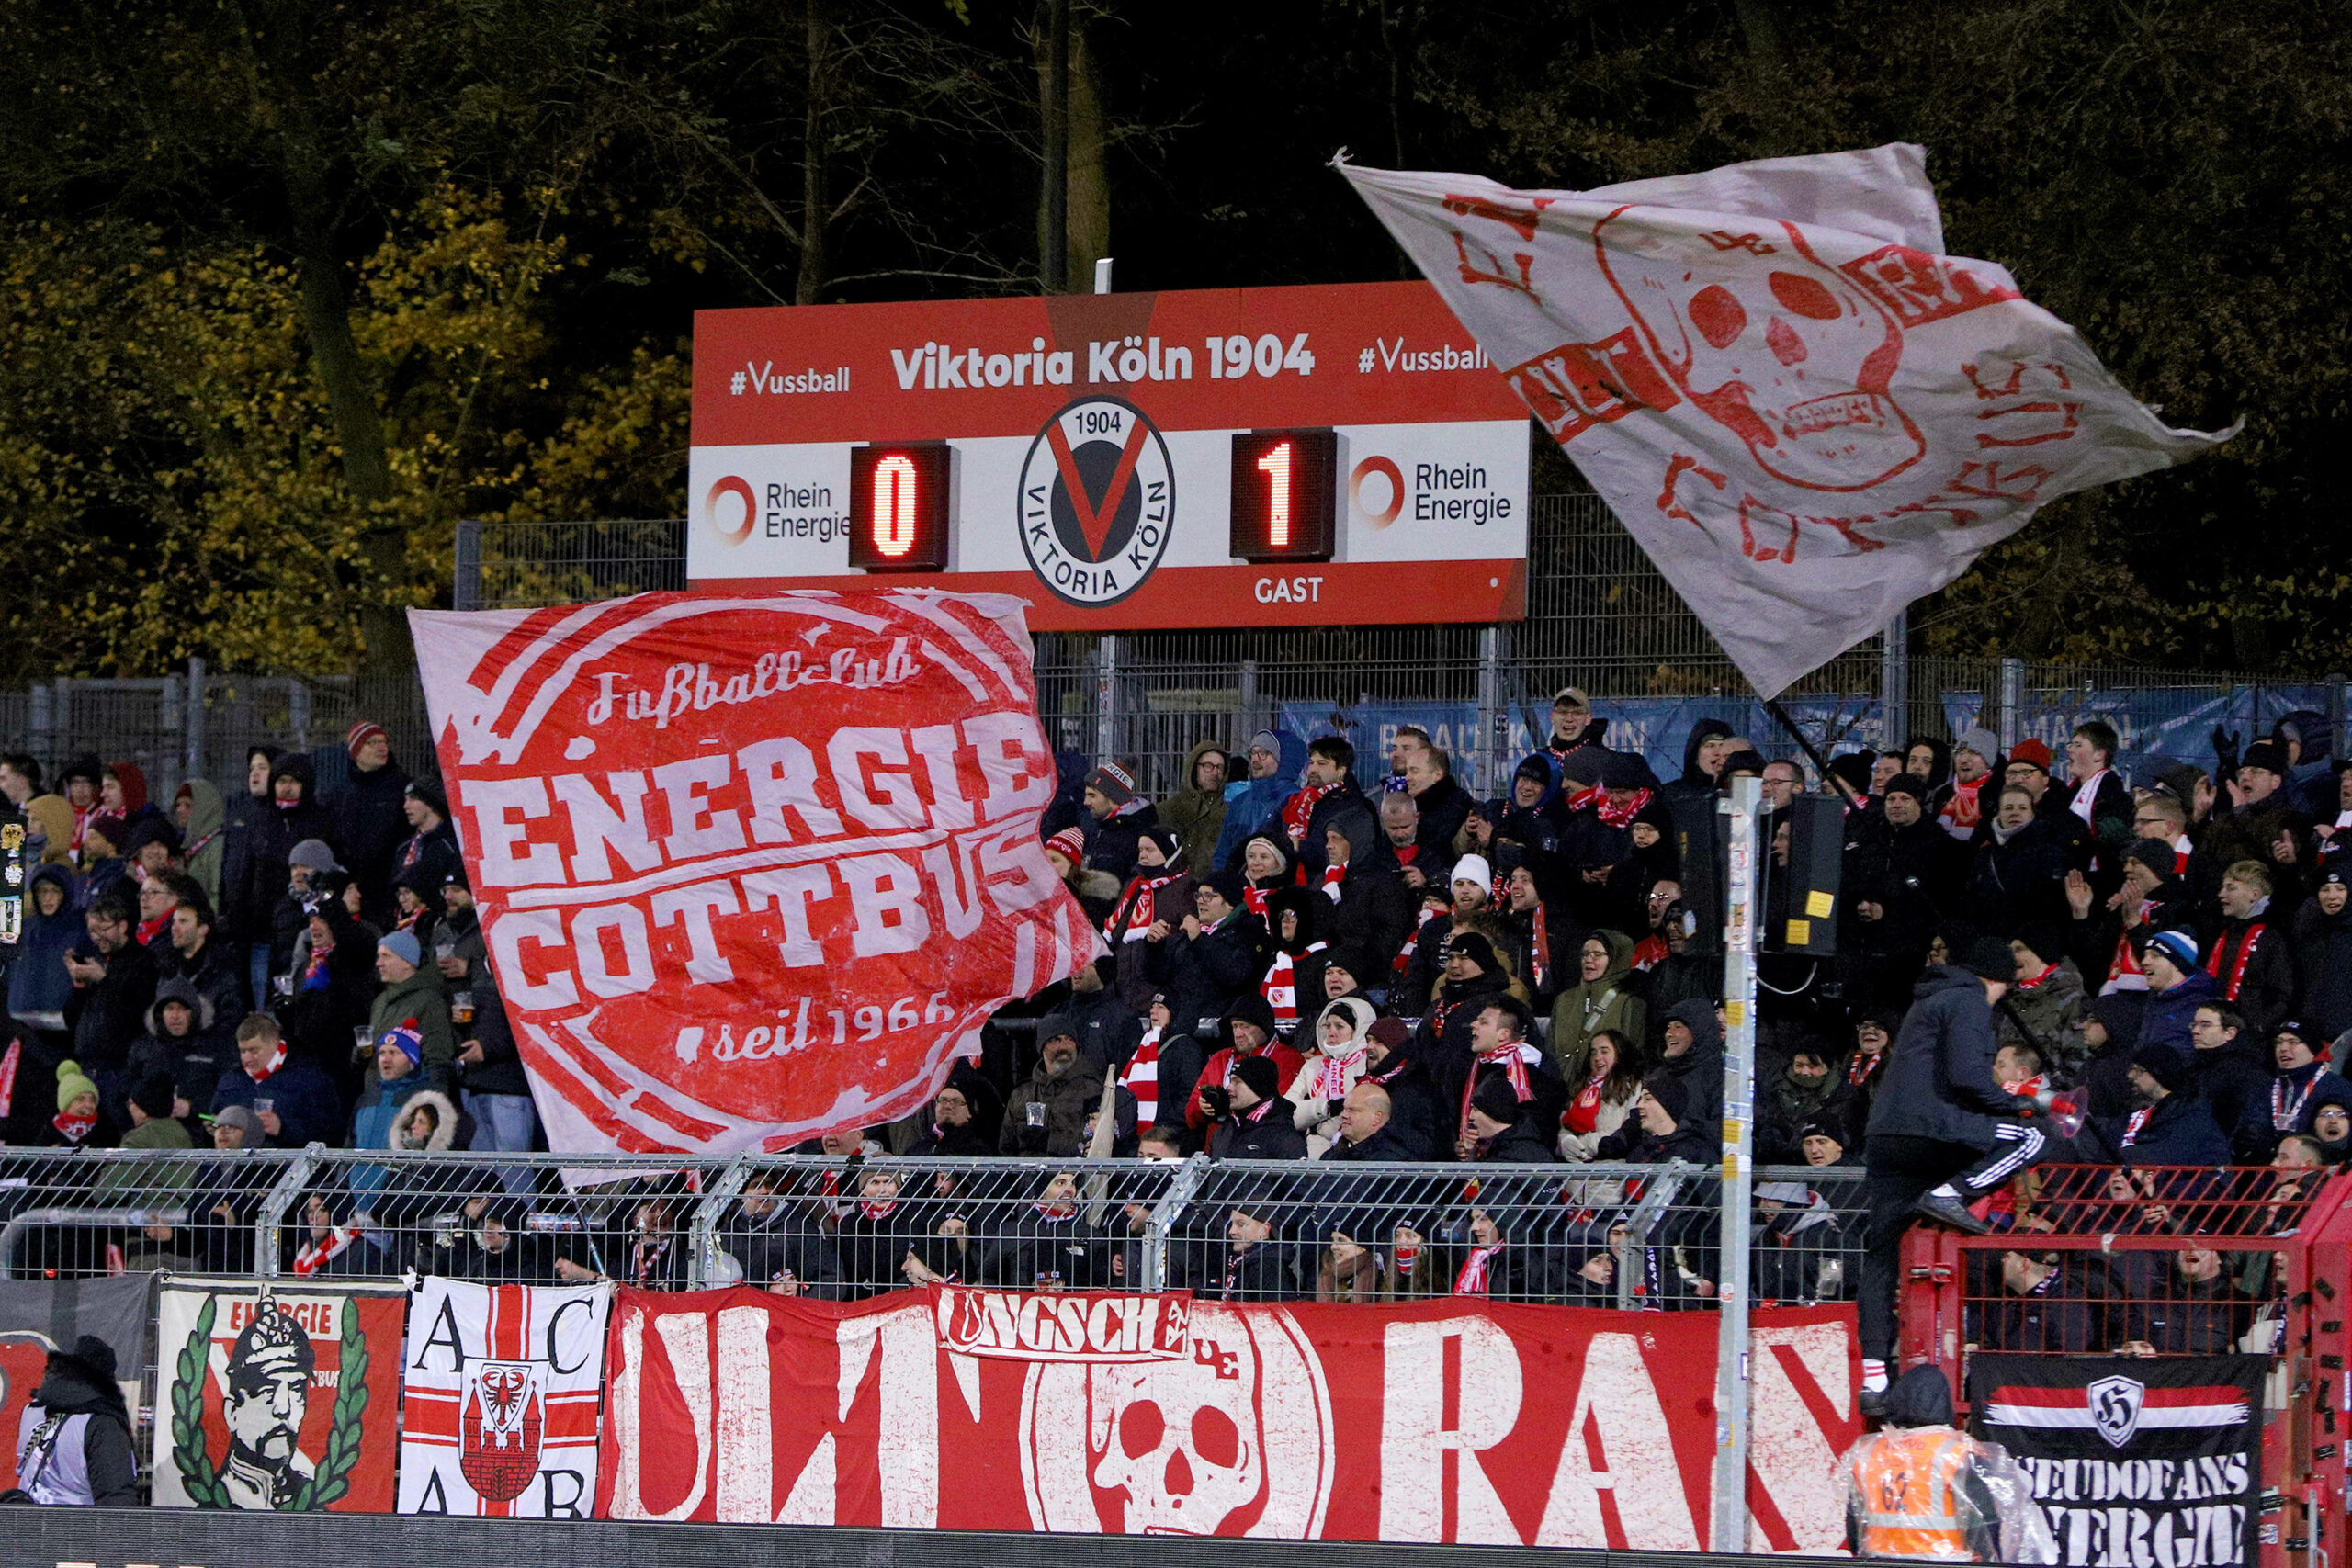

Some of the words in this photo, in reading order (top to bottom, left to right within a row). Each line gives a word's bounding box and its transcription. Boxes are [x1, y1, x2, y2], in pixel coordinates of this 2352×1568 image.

[890, 336, 1074, 390] Viktoria
[1088, 335, 1193, 383] Köln
[1206, 333, 1316, 379] 1904
[1358, 336, 1489, 374] #Vussball
[730, 360, 850, 396] #Vussball
[1075, 411, 1122, 434] 1904
[766, 482, 831, 509] Rhein
[1257, 442, 1291, 546] 1
[1416, 462, 1487, 490] Rhein
[766, 512, 851, 543] Energie
[873, 456, 917, 555] 0
[1415, 491, 1511, 525] Energie
[1028, 485, 1119, 596] VIKTORIA
[1128, 480, 1166, 571] KÖLN
[1254, 576, 1323, 604] GAST
[461, 712, 1052, 888] ENERGIE
[489, 825, 1061, 1012] COTTBUS
[712, 997, 818, 1062] seit
[827, 990, 956, 1045] 1966
[2017, 1452, 2250, 1502] SEUDOFANS
